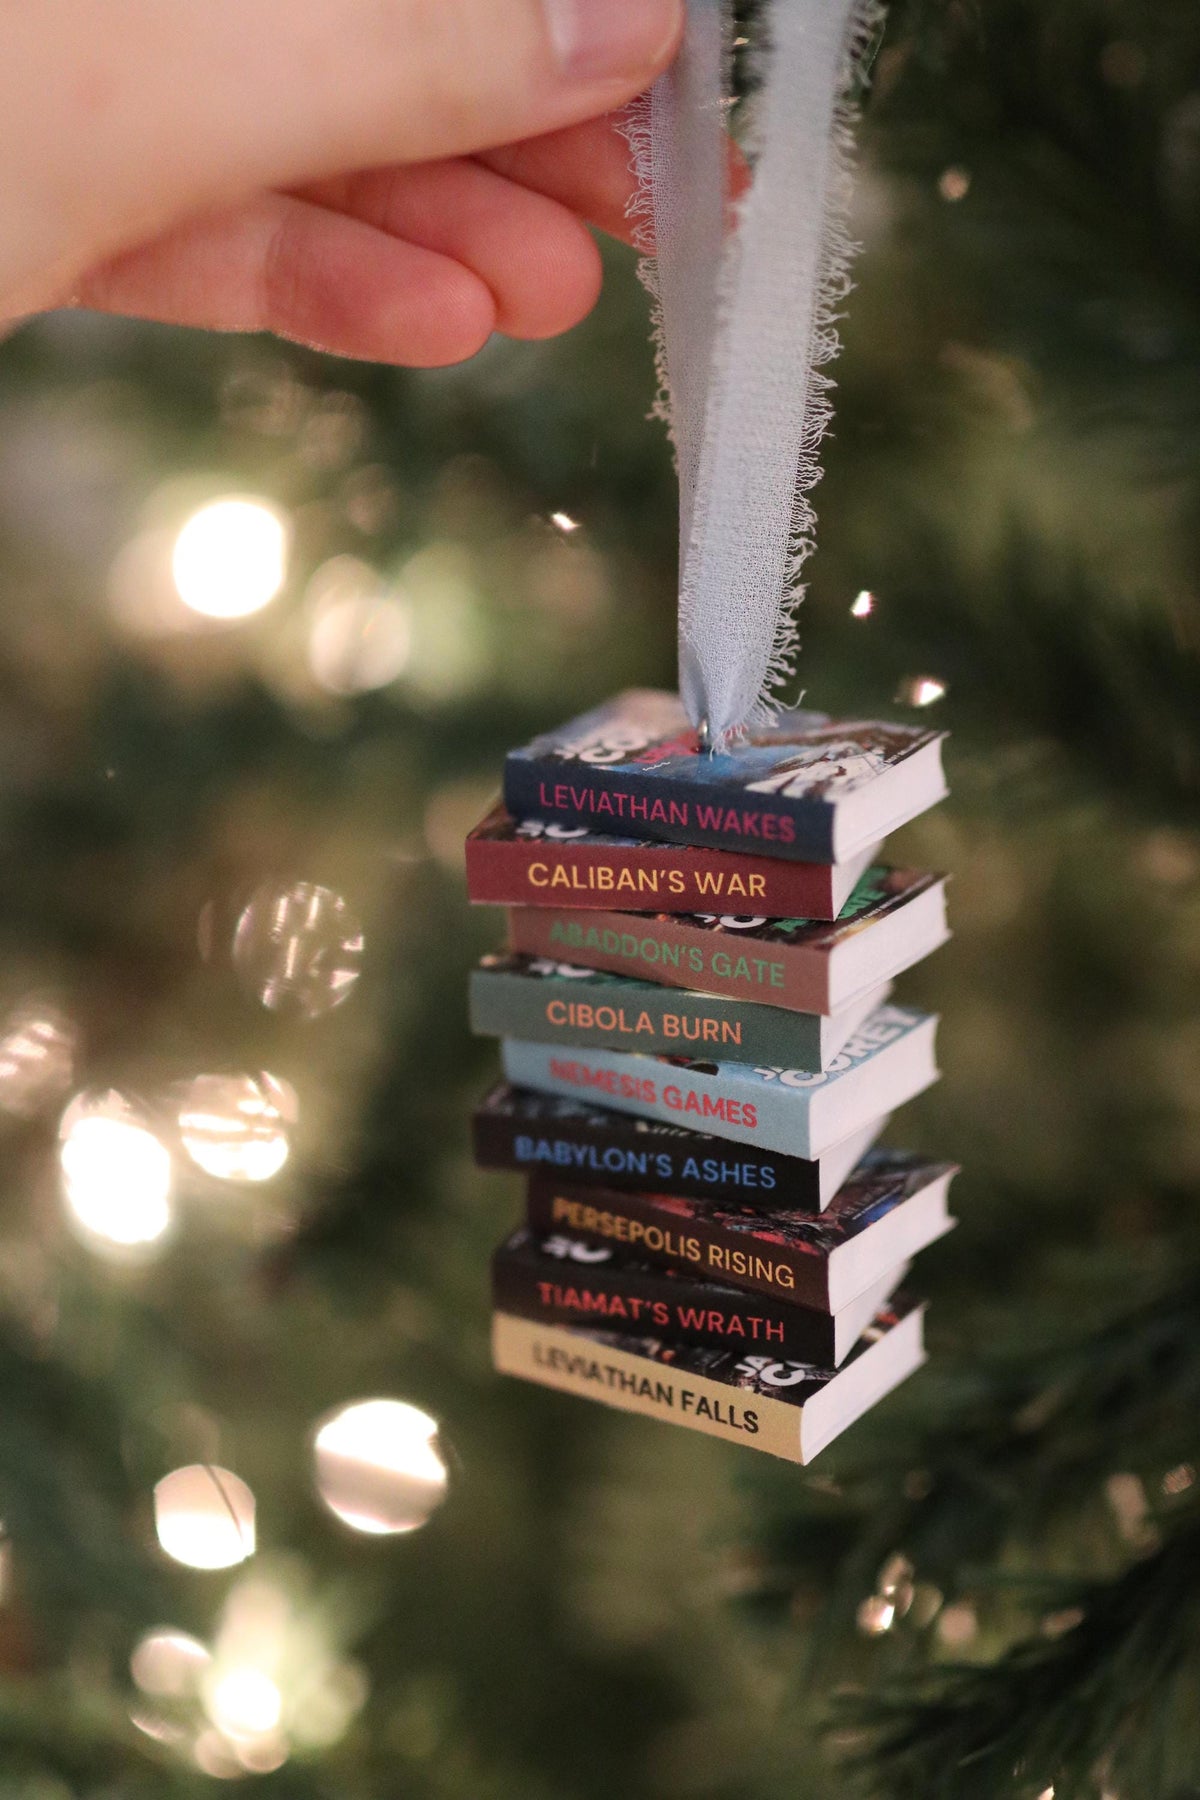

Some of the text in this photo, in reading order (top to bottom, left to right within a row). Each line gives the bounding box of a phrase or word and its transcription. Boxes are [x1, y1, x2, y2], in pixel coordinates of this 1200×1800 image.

[540, 783, 797, 843] LEVIATHAN WAKES
[527, 862, 767, 897] CALIBAN'S WAR
[549, 922, 786, 988] ABADDON'S GATE
[546, 1001, 742, 1044] CIBOLA BURN
[549, 1059, 758, 1128] NEMESIS GAMES
[514, 1134, 777, 1189] BABYLON'S ASHES
[552, 1197, 701, 1261] PERSEPOLIS
[709, 1245, 796, 1289] RISING
[539, 1282, 785, 1343] TIAMAT'S WRATH
[534, 1342, 674, 1406] LEVIATHAN
[681, 1391, 760, 1434] FALLS
